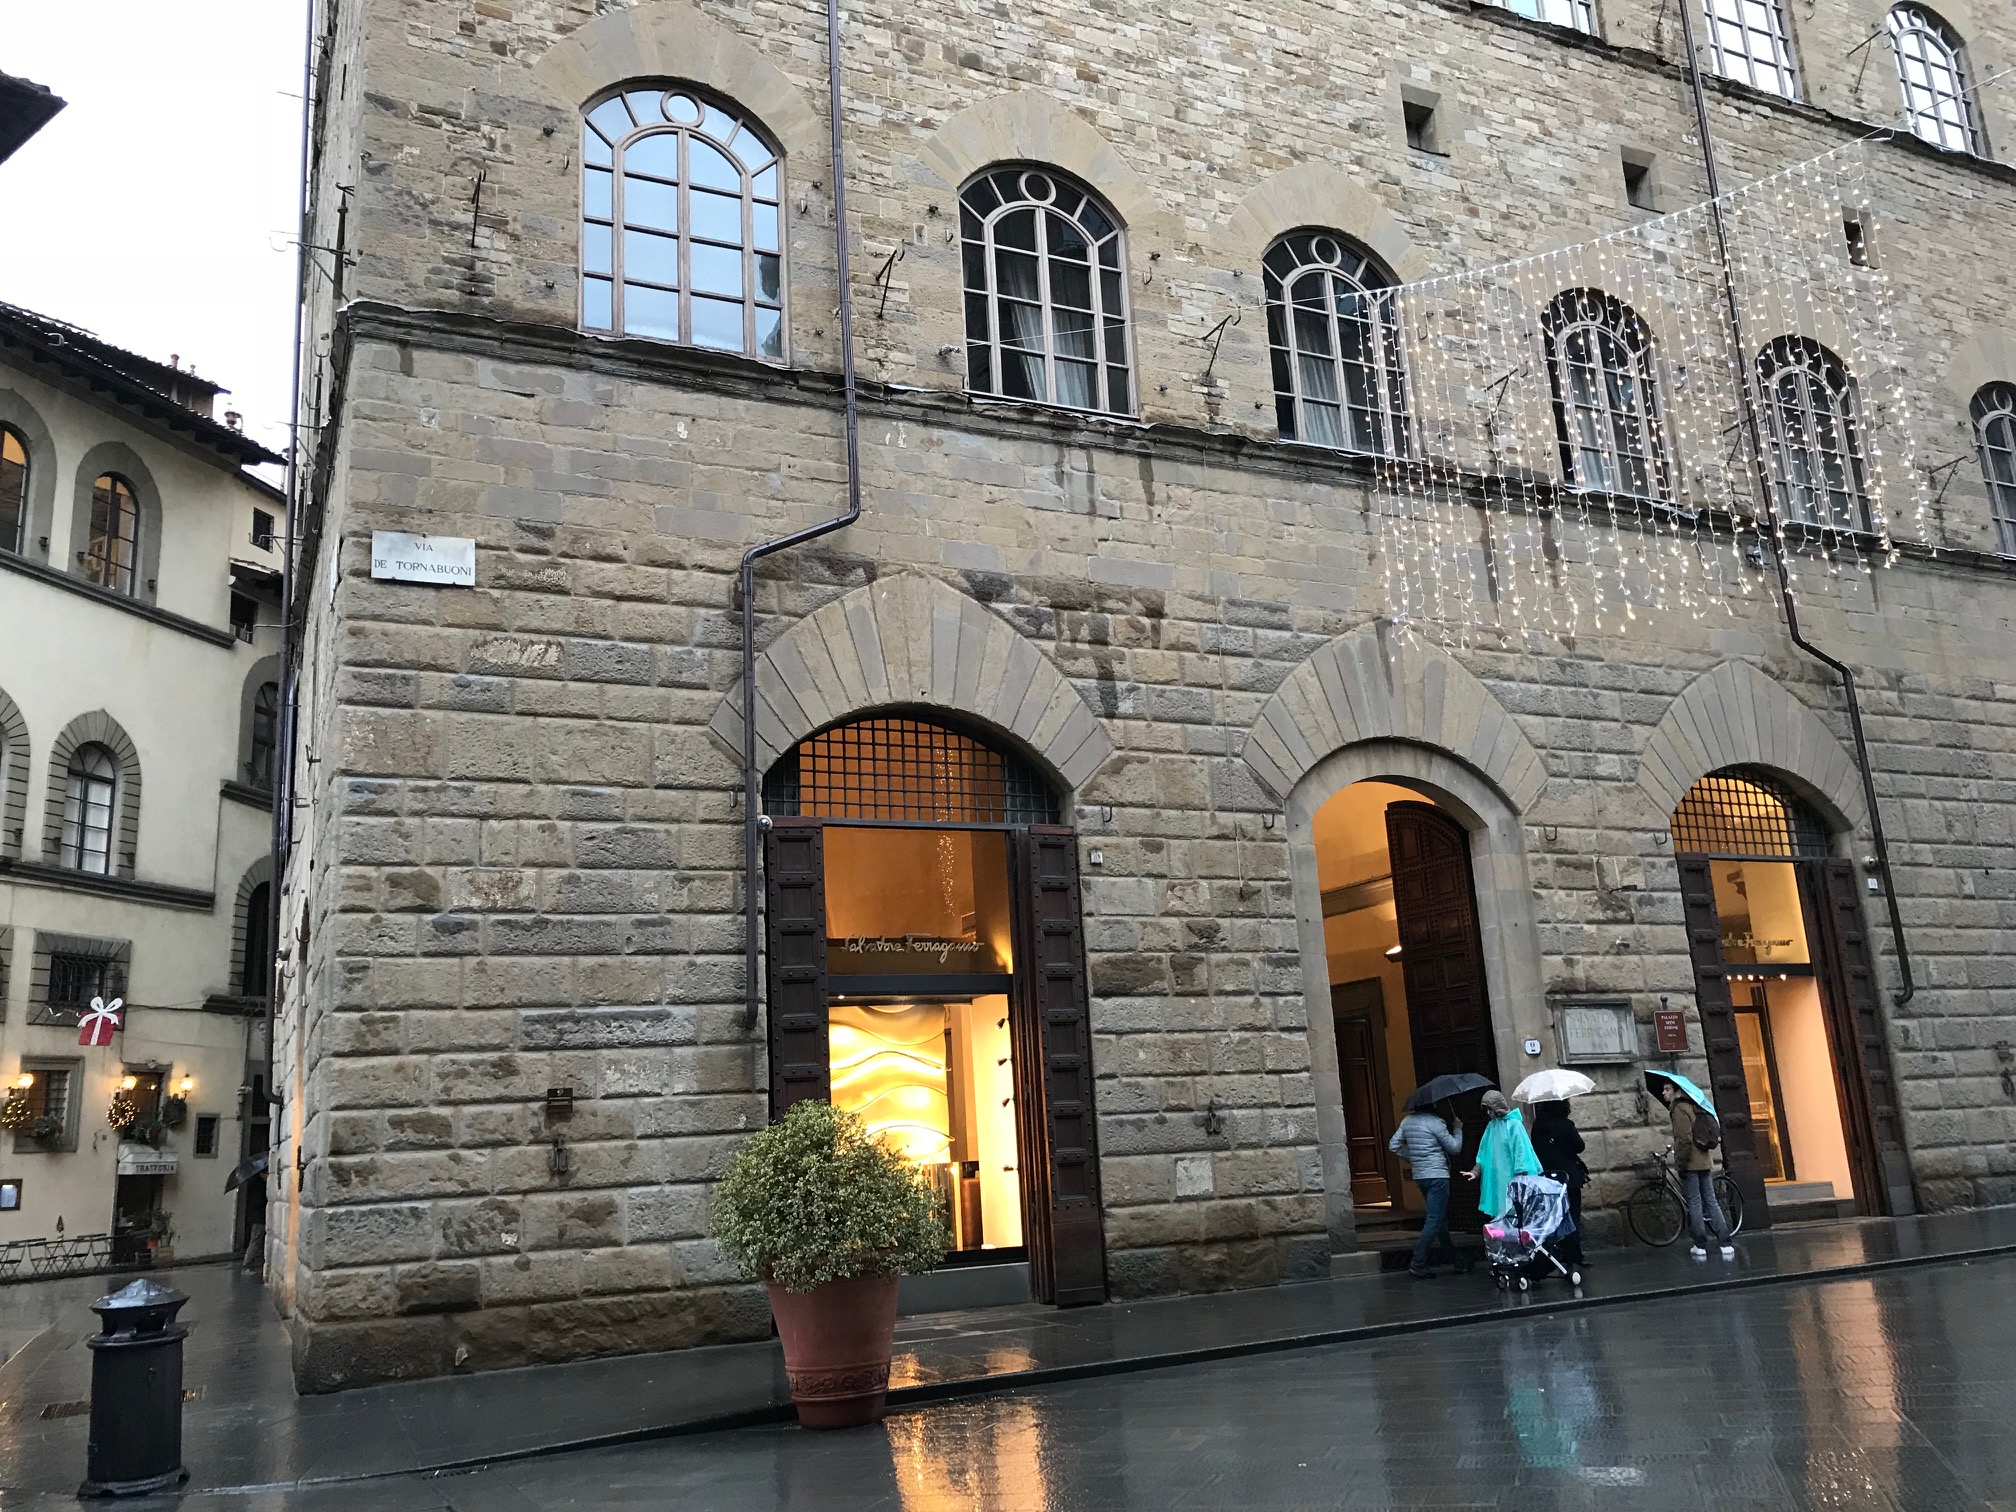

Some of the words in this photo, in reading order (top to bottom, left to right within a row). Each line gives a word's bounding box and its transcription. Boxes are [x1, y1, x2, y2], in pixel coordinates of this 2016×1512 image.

[414, 542, 434, 552] VIA
[374, 559, 388, 569] DE
[396, 560, 472, 577] TORNABUONI
[841, 933, 905, 954] Salvatore
[904, 932, 985, 964] Ferragamo
[135, 1164, 174, 1172] TRATTORIA
